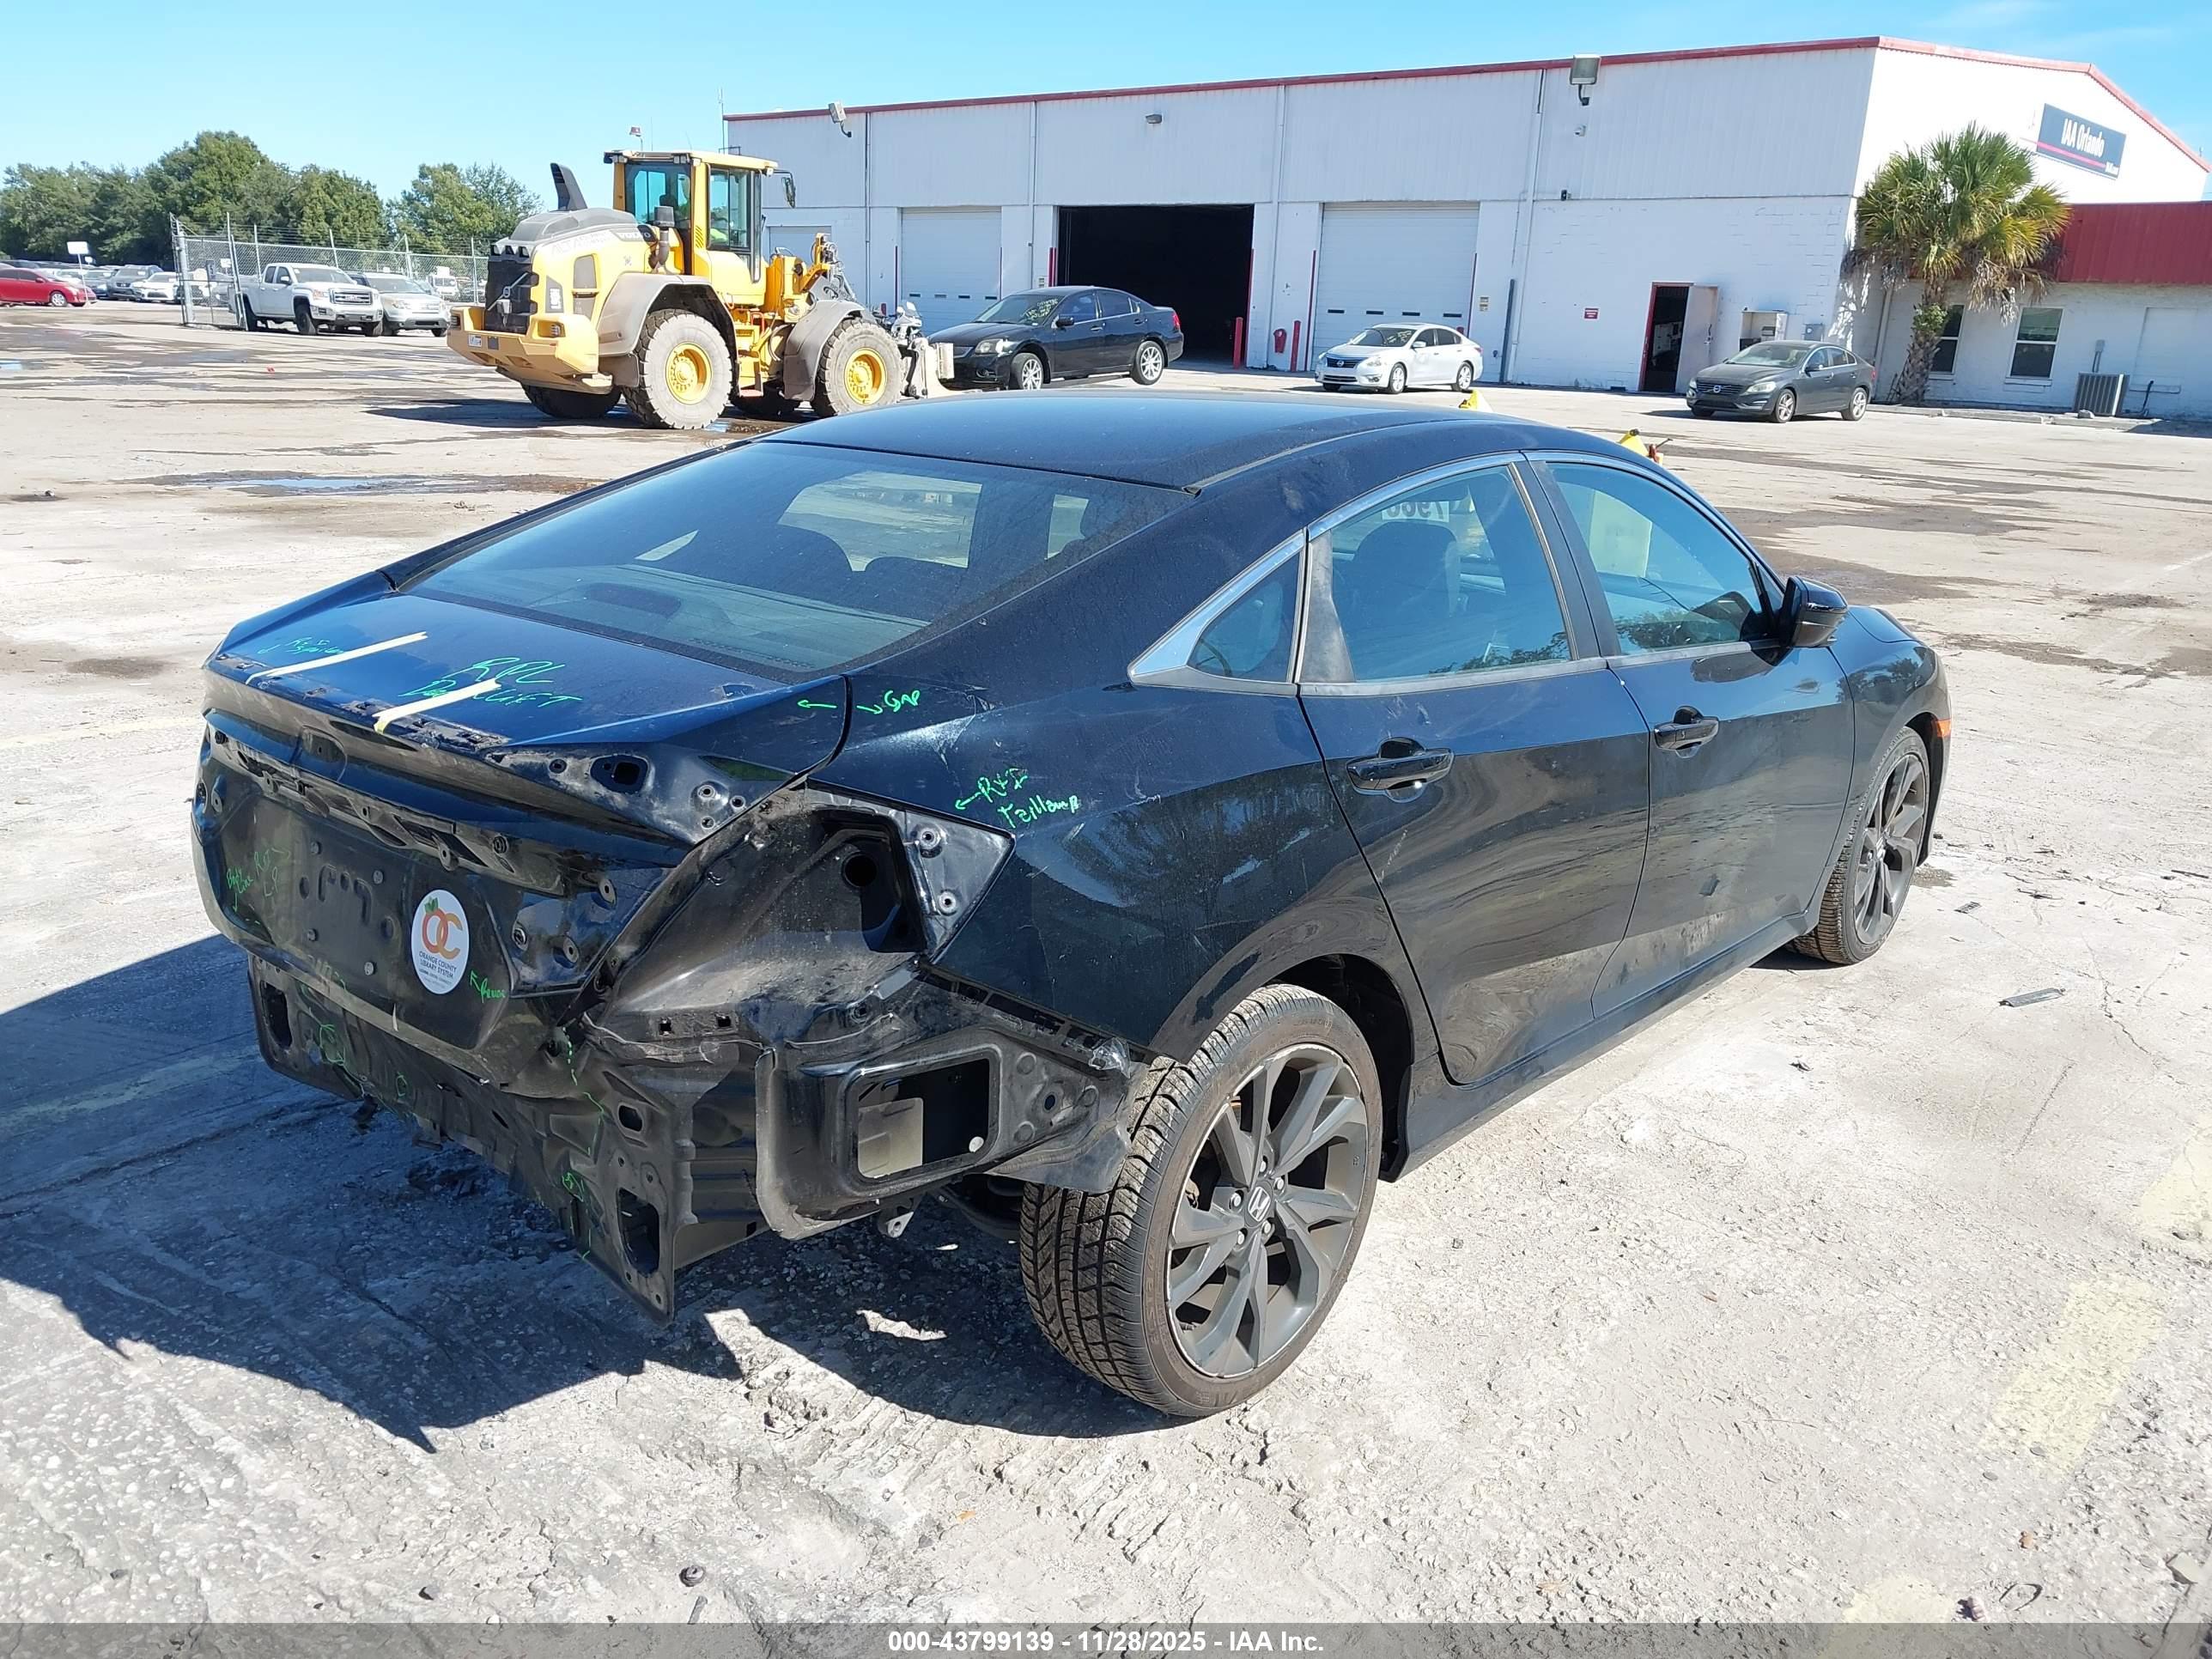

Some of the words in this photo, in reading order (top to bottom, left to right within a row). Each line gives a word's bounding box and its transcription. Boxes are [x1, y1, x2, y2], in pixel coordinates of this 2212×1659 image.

[2061, 118, 2077, 149] IAA
[2076, 124, 2106, 158] Orlando
[418, 951, 438, 963] ORANGE
[438, 959, 457, 972] COUNTY
[420, 958, 437, 971] LIBRARY
[437, 966, 453, 978] SYSTEM
